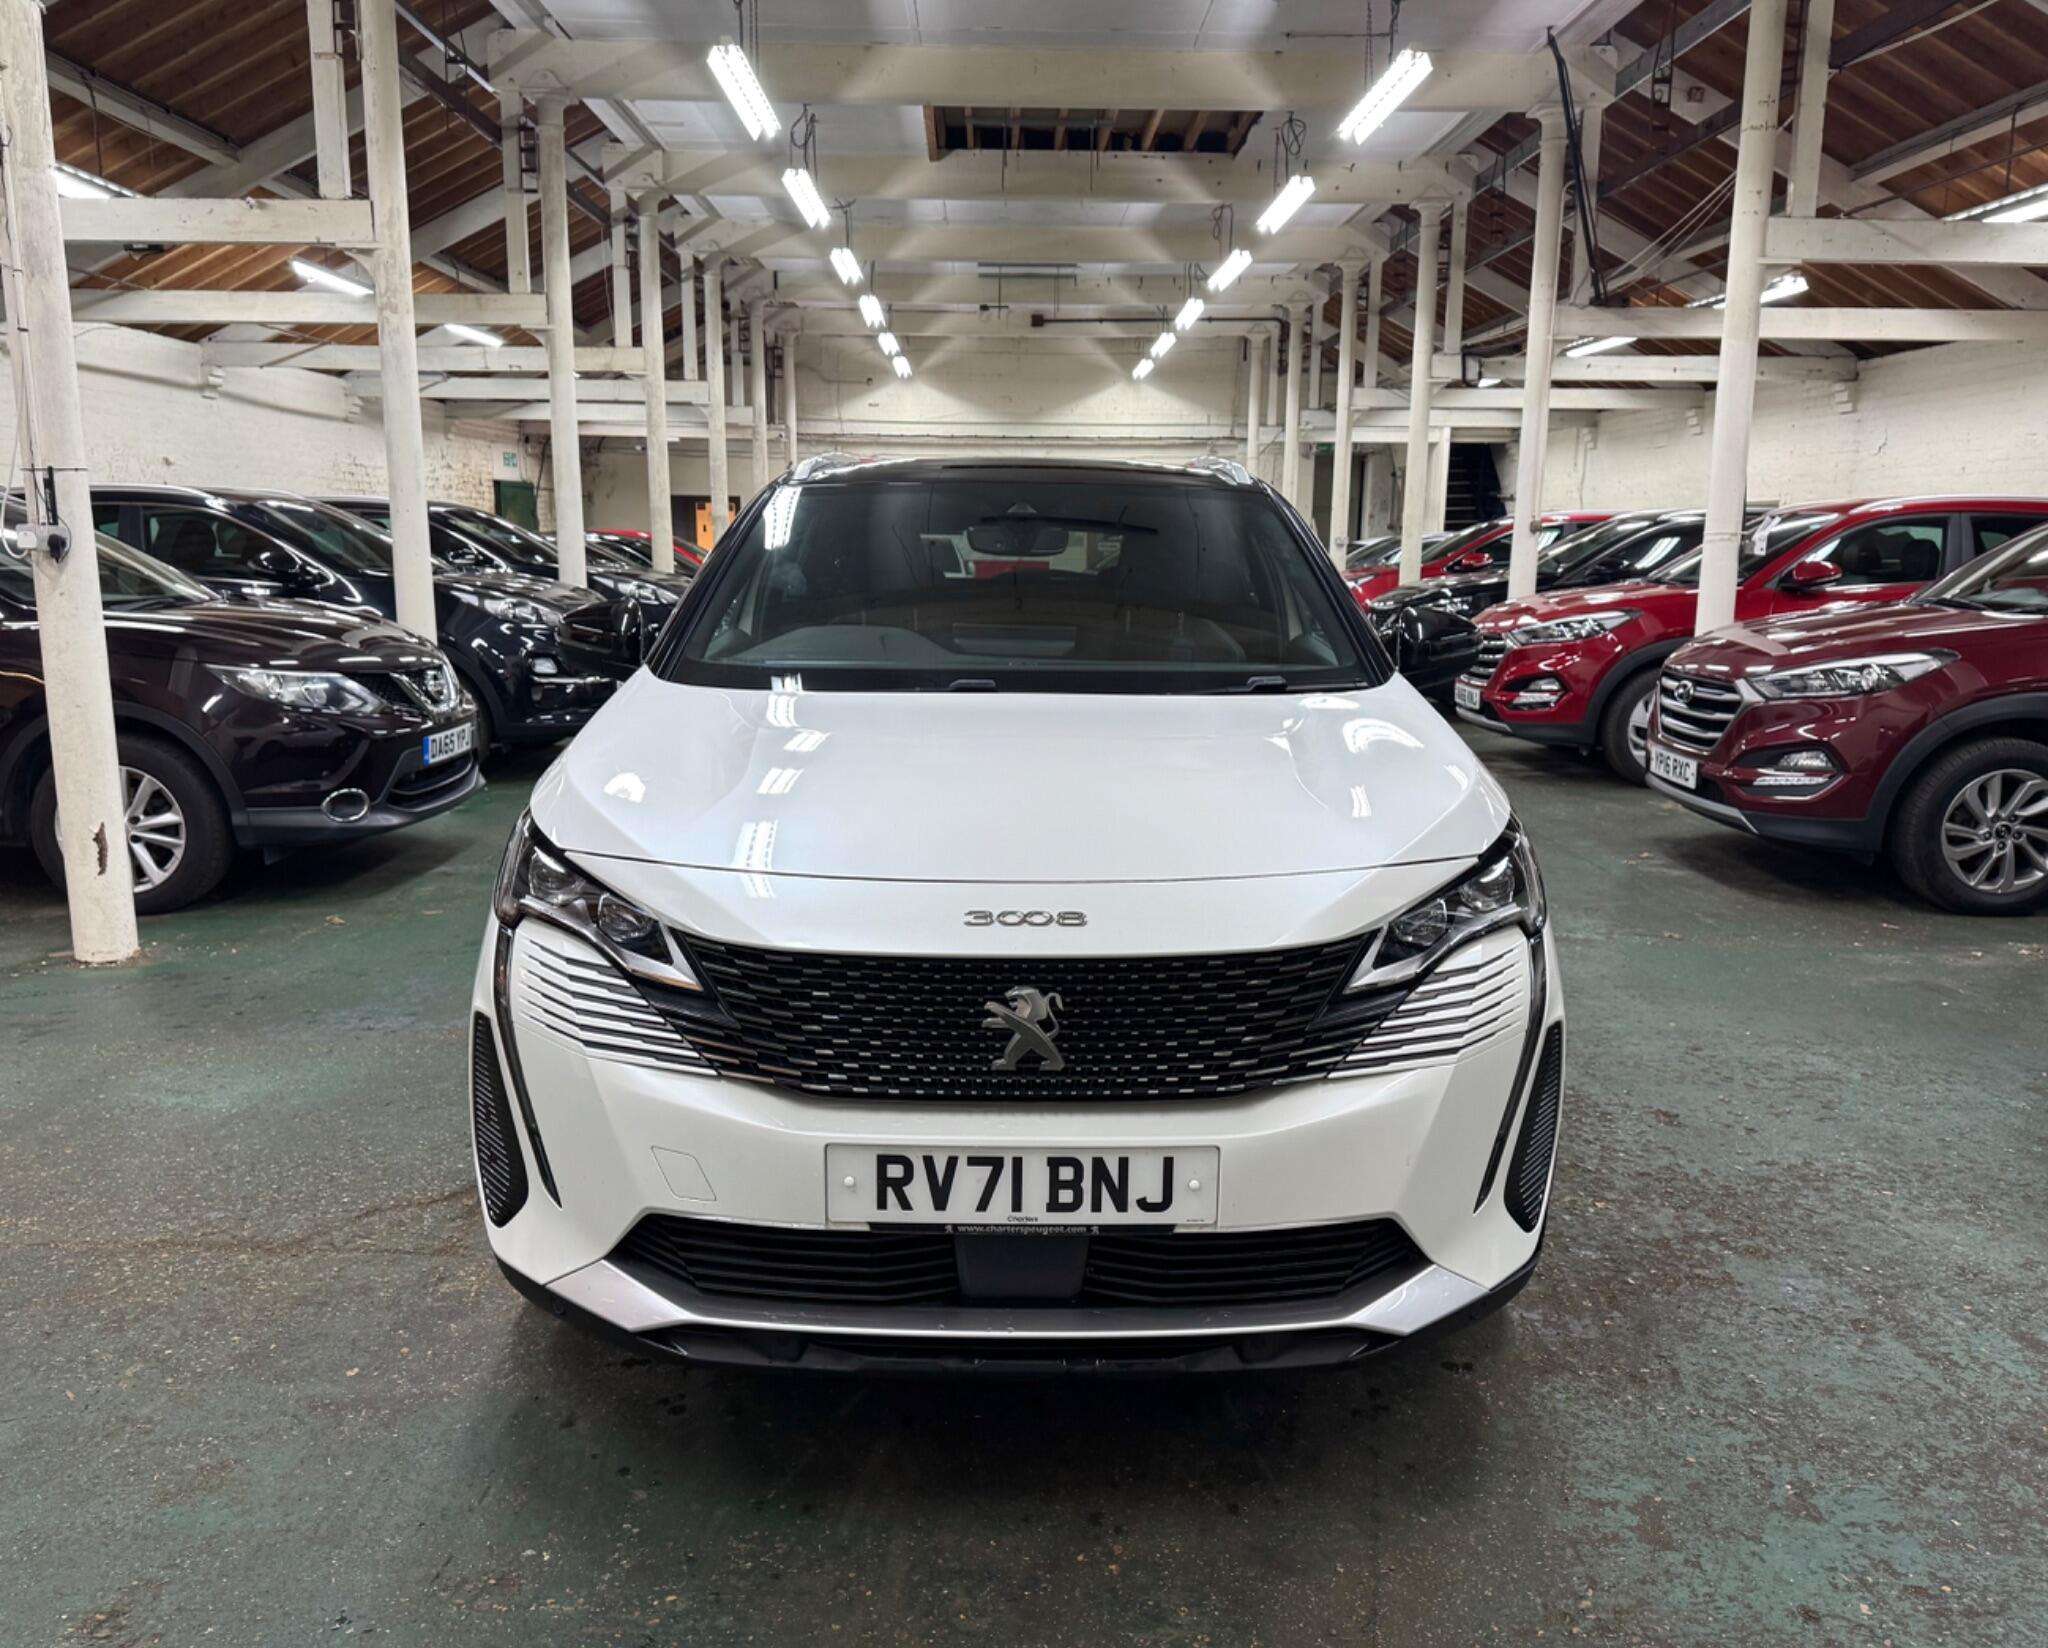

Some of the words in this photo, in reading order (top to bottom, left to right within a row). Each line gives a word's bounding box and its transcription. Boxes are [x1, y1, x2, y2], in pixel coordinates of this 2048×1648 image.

[964, 910, 1087, 926] 3008
[877, 1154, 1023, 1213] RV71
[1046, 1156, 1174, 1213] BNJ
[957, 1225, 1087, 1235] www.charterspeugeot.com
